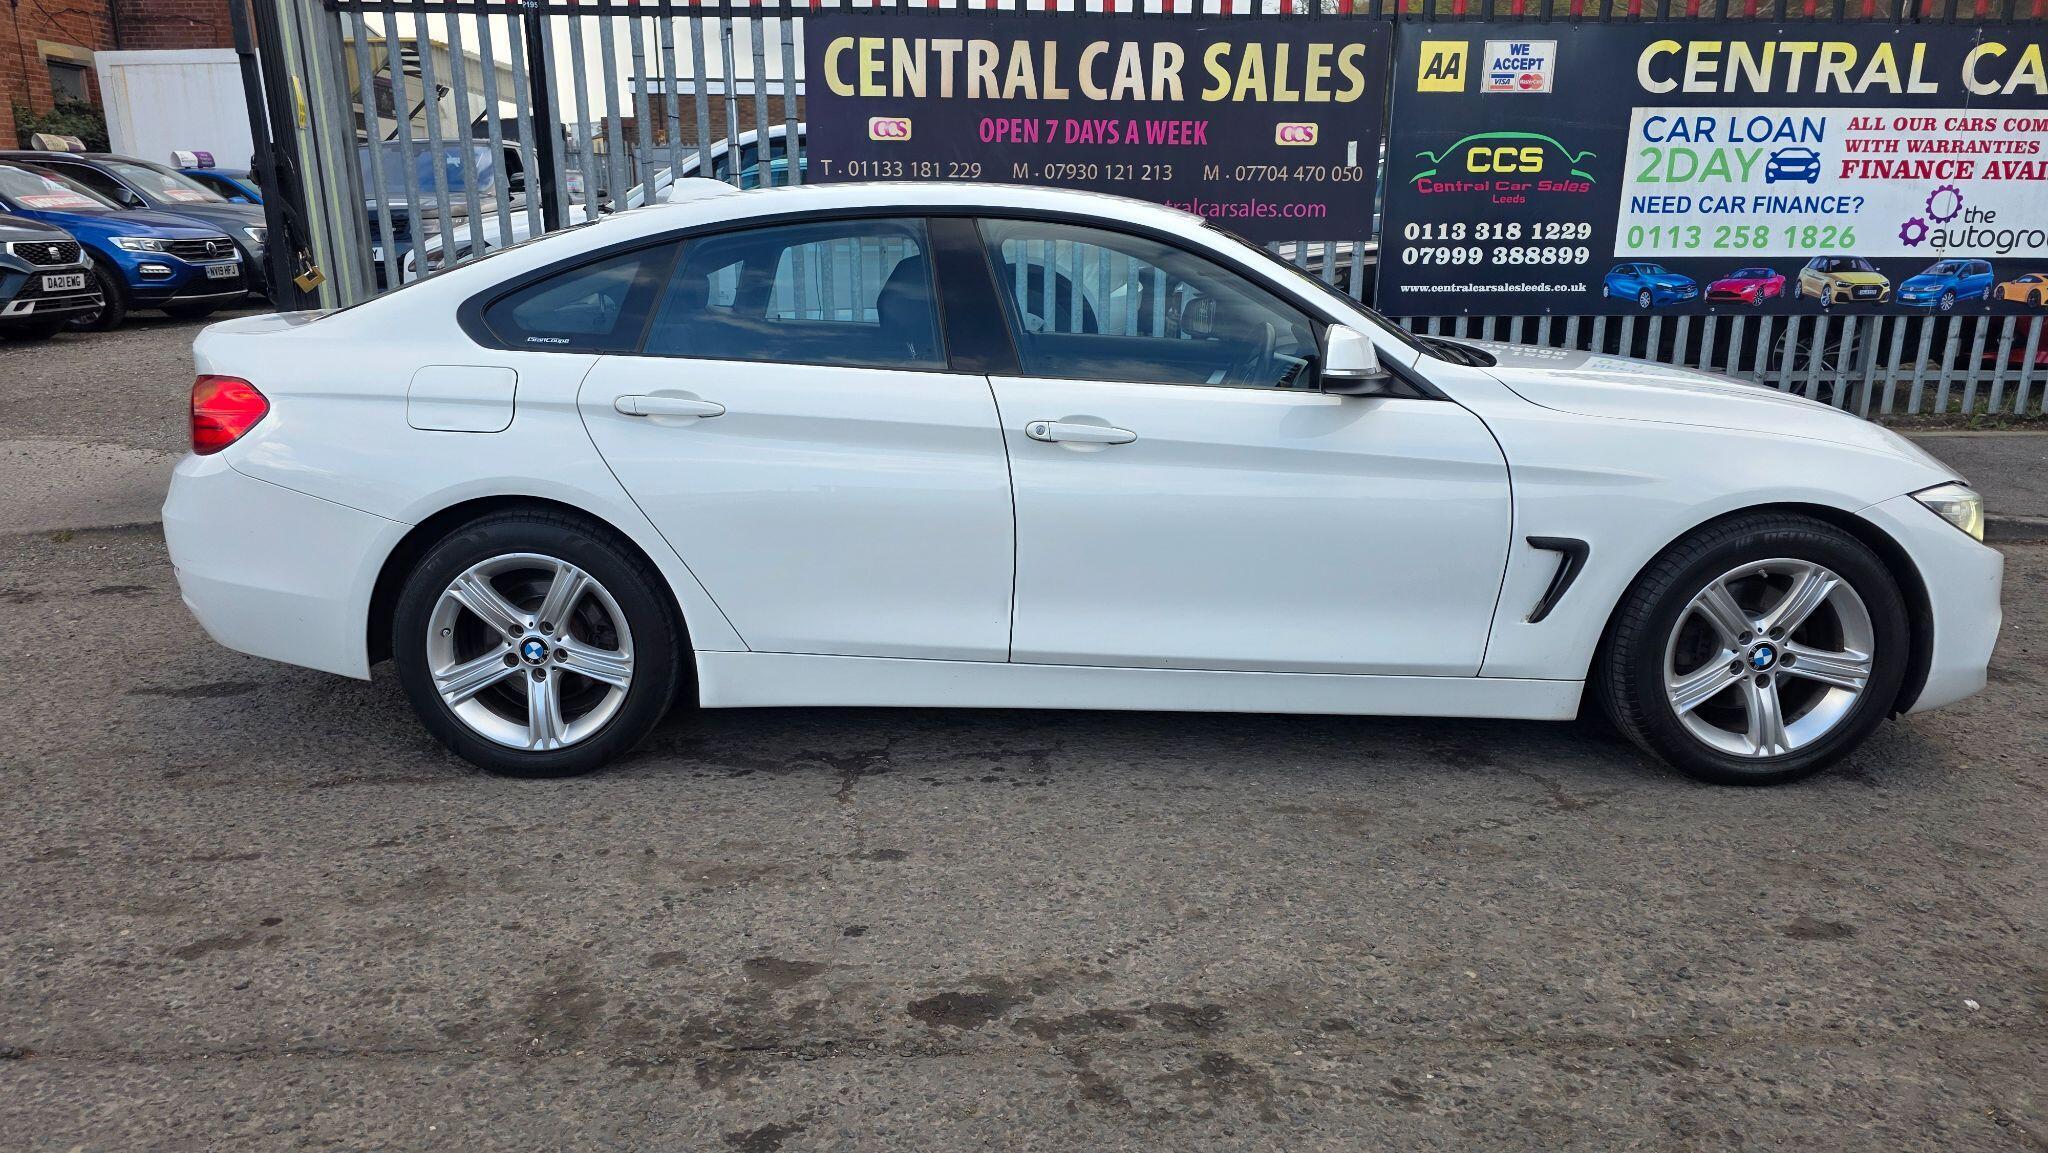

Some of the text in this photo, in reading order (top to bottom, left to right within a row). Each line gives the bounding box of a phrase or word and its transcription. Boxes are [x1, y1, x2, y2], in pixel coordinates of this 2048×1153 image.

[1510, 43, 1531, 56] WE
[824, 36, 1366, 103] CENTRAL CAR SALES
[1423, 52, 1461, 80] AA
[1493, 57, 1545, 71] ACCEPT
[1636, 39, 2048, 96] CENTRAL CA
[873, 120, 908, 138] CCS
[979, 117, 1208, 146] OPEN 7 DAYS A WEEK
[1280, 125, 1314, 143] CCS
[1642, 115, 1826, 143] CAR LOAN
[1847, 117, 2048, 132] ALL OUR CARS COM
[1845, 139, 2040, 155] WITH WARRANTIES
[848, 160, 903, 177] 01133
[911, 161, 940, 178] 181
[948, 162, 982, 178] 229
[1466, 147, 1544, 173] CCS
[1636, 147, 1764, 183] 2DAY
[1044, 163, 1098, 179] 07930
[1105, 164, 1134, 180] 121
[1141, 164, 1173, 181] 213
[1235, 165, 1288, 182] 07704
[1293, 166, 1326, 182] 470
[1331, 165, 1363, 182] 050
[1839, 160, 1975, 180] FINANCE
[1417, 178, 1591, 194] Central Car Sales
[1492, 194, 1526, 204] Leeds
[1631, 195, 1865, 214] NEED CAR FINANCE?
[1964, 205, 1997, 224] the
[1404, 222, 1592, 241] 0113 318 1229
[1627, 225, 1857, 249] 0113 258 1826
[1930, 225, 2048, 255] autogro
[1402, 246, 1590, 265] 07999 388899
[47, 276, 66, 289] DA21
[1400, 282, 1587, 293] www.centralcarsalesleeds.co.uk
